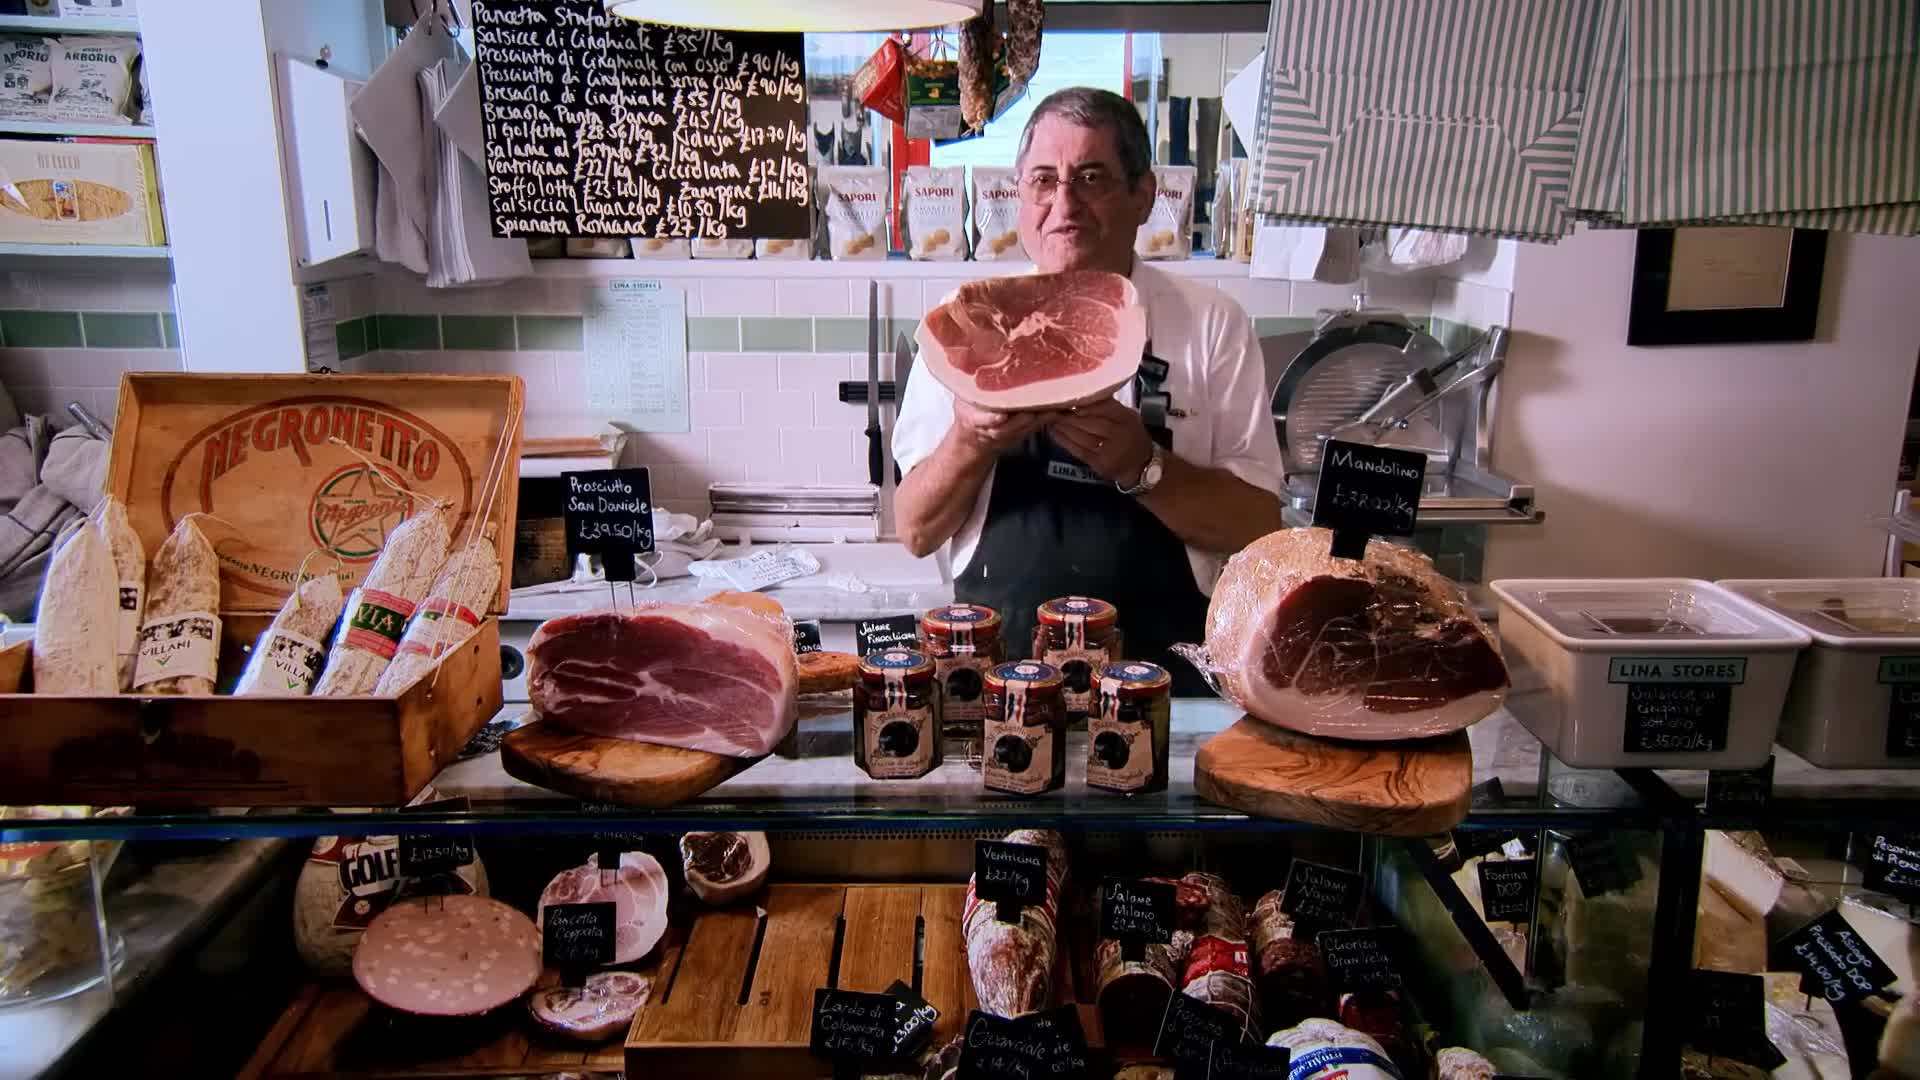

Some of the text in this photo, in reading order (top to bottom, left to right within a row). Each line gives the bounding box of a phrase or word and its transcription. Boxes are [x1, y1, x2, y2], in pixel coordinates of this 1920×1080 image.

[546, 29, 564, 47] di
[64, 52, 118, 63] ARBORIO
[477, 46, 554, 66] Prosciutto
[559, 51, 574, 68] di
[738, 51, 800, 79] £90/kg
[481, 63, 554, 84] Prosciutto
[562, 67, 580, 84] di
[746, 72, 803, 103] £90/kg
[561, 86, 576, 103] di
[672, 87, 742, 118] £55/kg
[675, 109, 745, 136] £45/kg
[839, 192, 877, 201] SAPORI
[915, 187, 954, 198] SAPORI
[493, 198, 569, 213] Salsiccia
[496, 216, 570, 239] Spianata
[656, 216, 727, 240] £27/kg
[200, 406, 440, 514] NEGRONETTO
[1331, 450, 1420, 479] Mandolino
[571, 476, 632, 495] Prosciutto
[142, 639, 191, 656] VILLANI
[1620, 664, 1736, 678] LINA STORES
[1846, 967, 1873, 991] DOP
